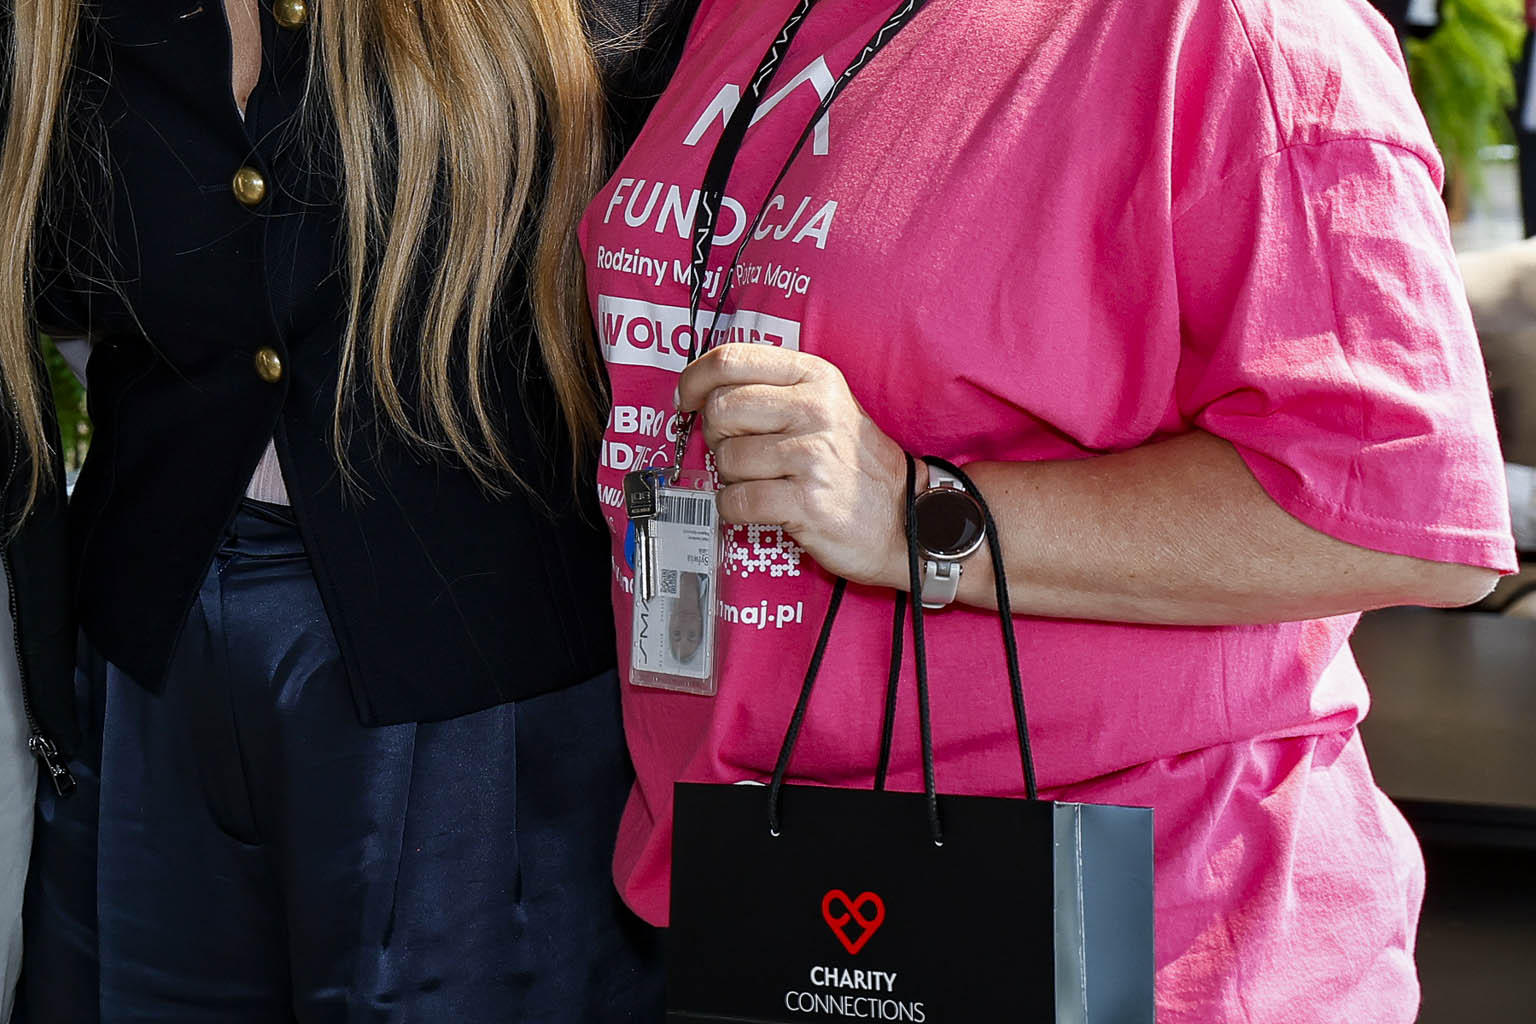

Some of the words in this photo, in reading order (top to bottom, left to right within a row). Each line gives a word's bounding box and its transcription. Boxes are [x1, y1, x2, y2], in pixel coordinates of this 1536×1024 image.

[603, 178, 839, 250] FUNDCJA
[597, 245, 668, 286] Rodziny
[764, 262, 811, 298] Maja
[810, 966, 897, 993] CHARITY
[785, 990, 925, 1023] CONNECTIONS
